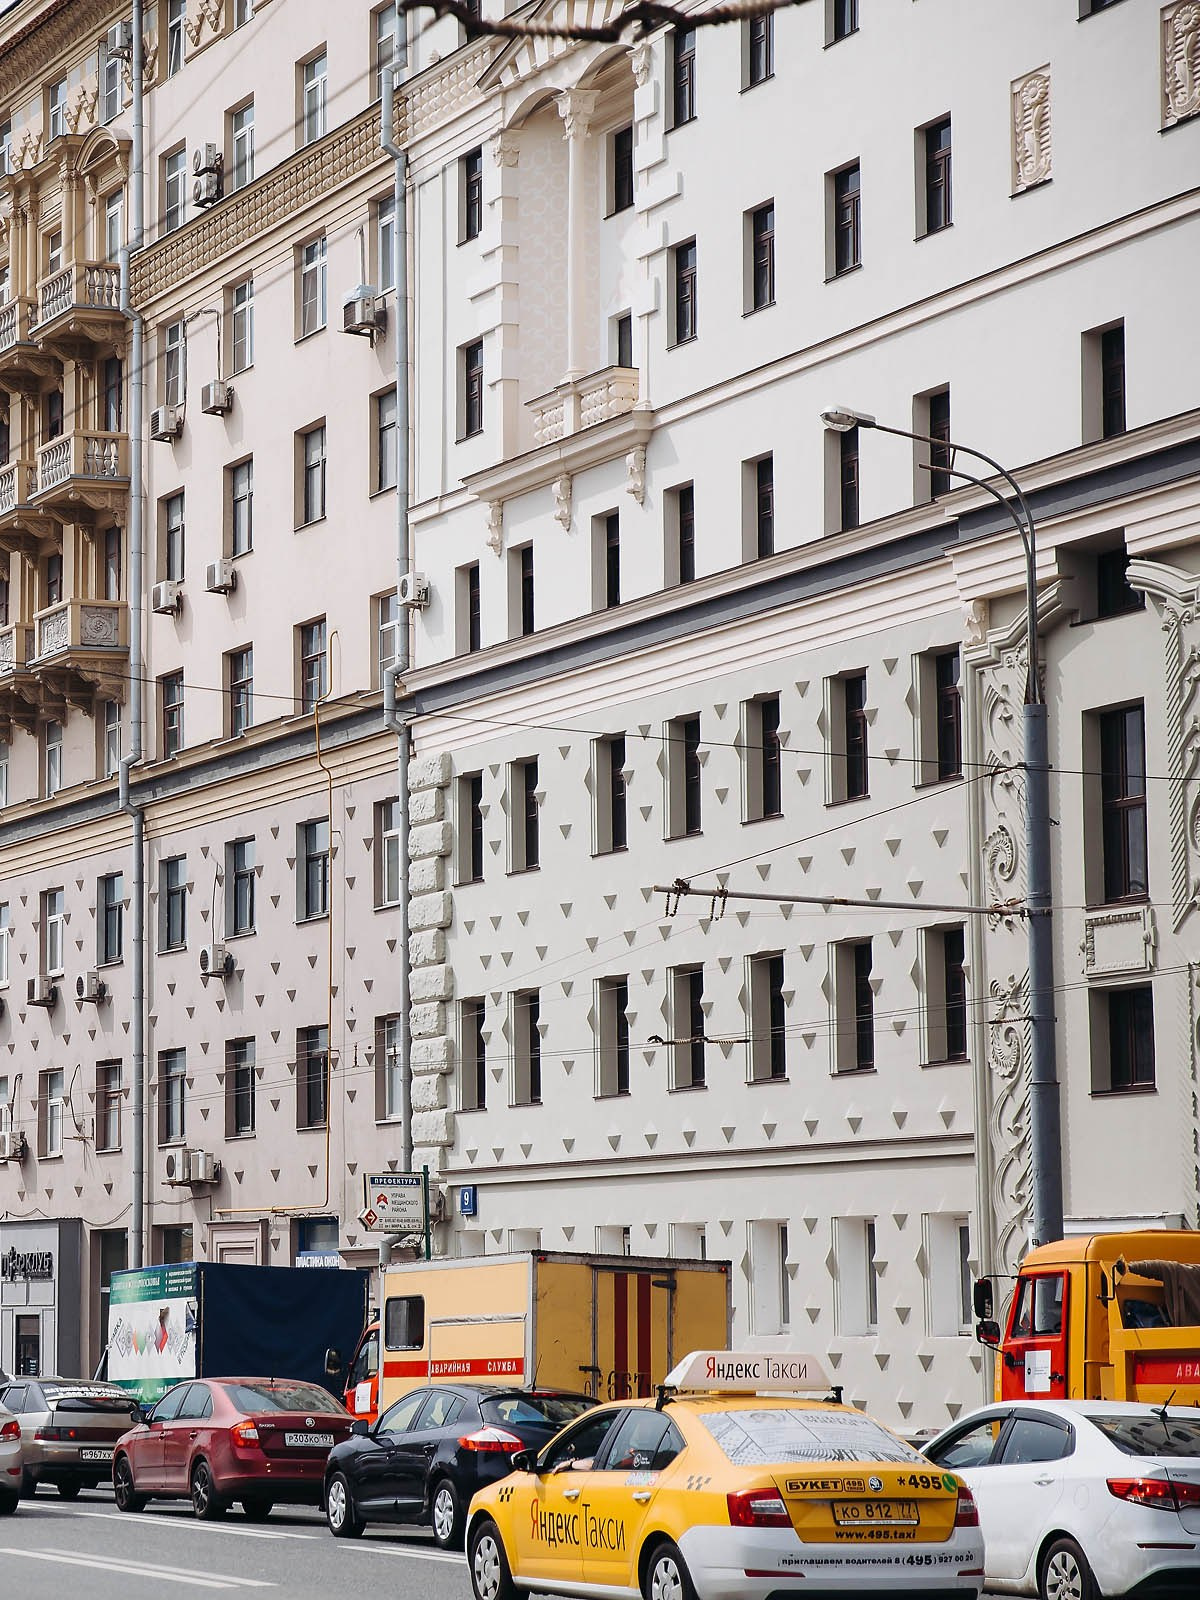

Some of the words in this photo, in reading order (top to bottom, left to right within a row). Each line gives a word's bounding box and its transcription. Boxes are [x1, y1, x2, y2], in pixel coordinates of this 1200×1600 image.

[464, 1192, 469, 1205] 9
[487, 1361, 517, 1372] СЛУЖБА
[706, 1357, 760, 1381] Яндекс
[764, 1358, 807, 1379] Такси
[788, 1480, 840, 1491] БУКЕТ
[865, 1503, 892, 1518] 812
[900, 1503, 912, 1515] 77
[530, 1498, 580, 1548] Яндекс
[582, 1503, 626, 1551] Такси
[835, 1529, 916, 1539] www.495.taxi
[782, 1557, 843, 1566] приглашаем
[845, 1555, 893, 1565] водителей
[938, 1555, 952, 1563] 927
